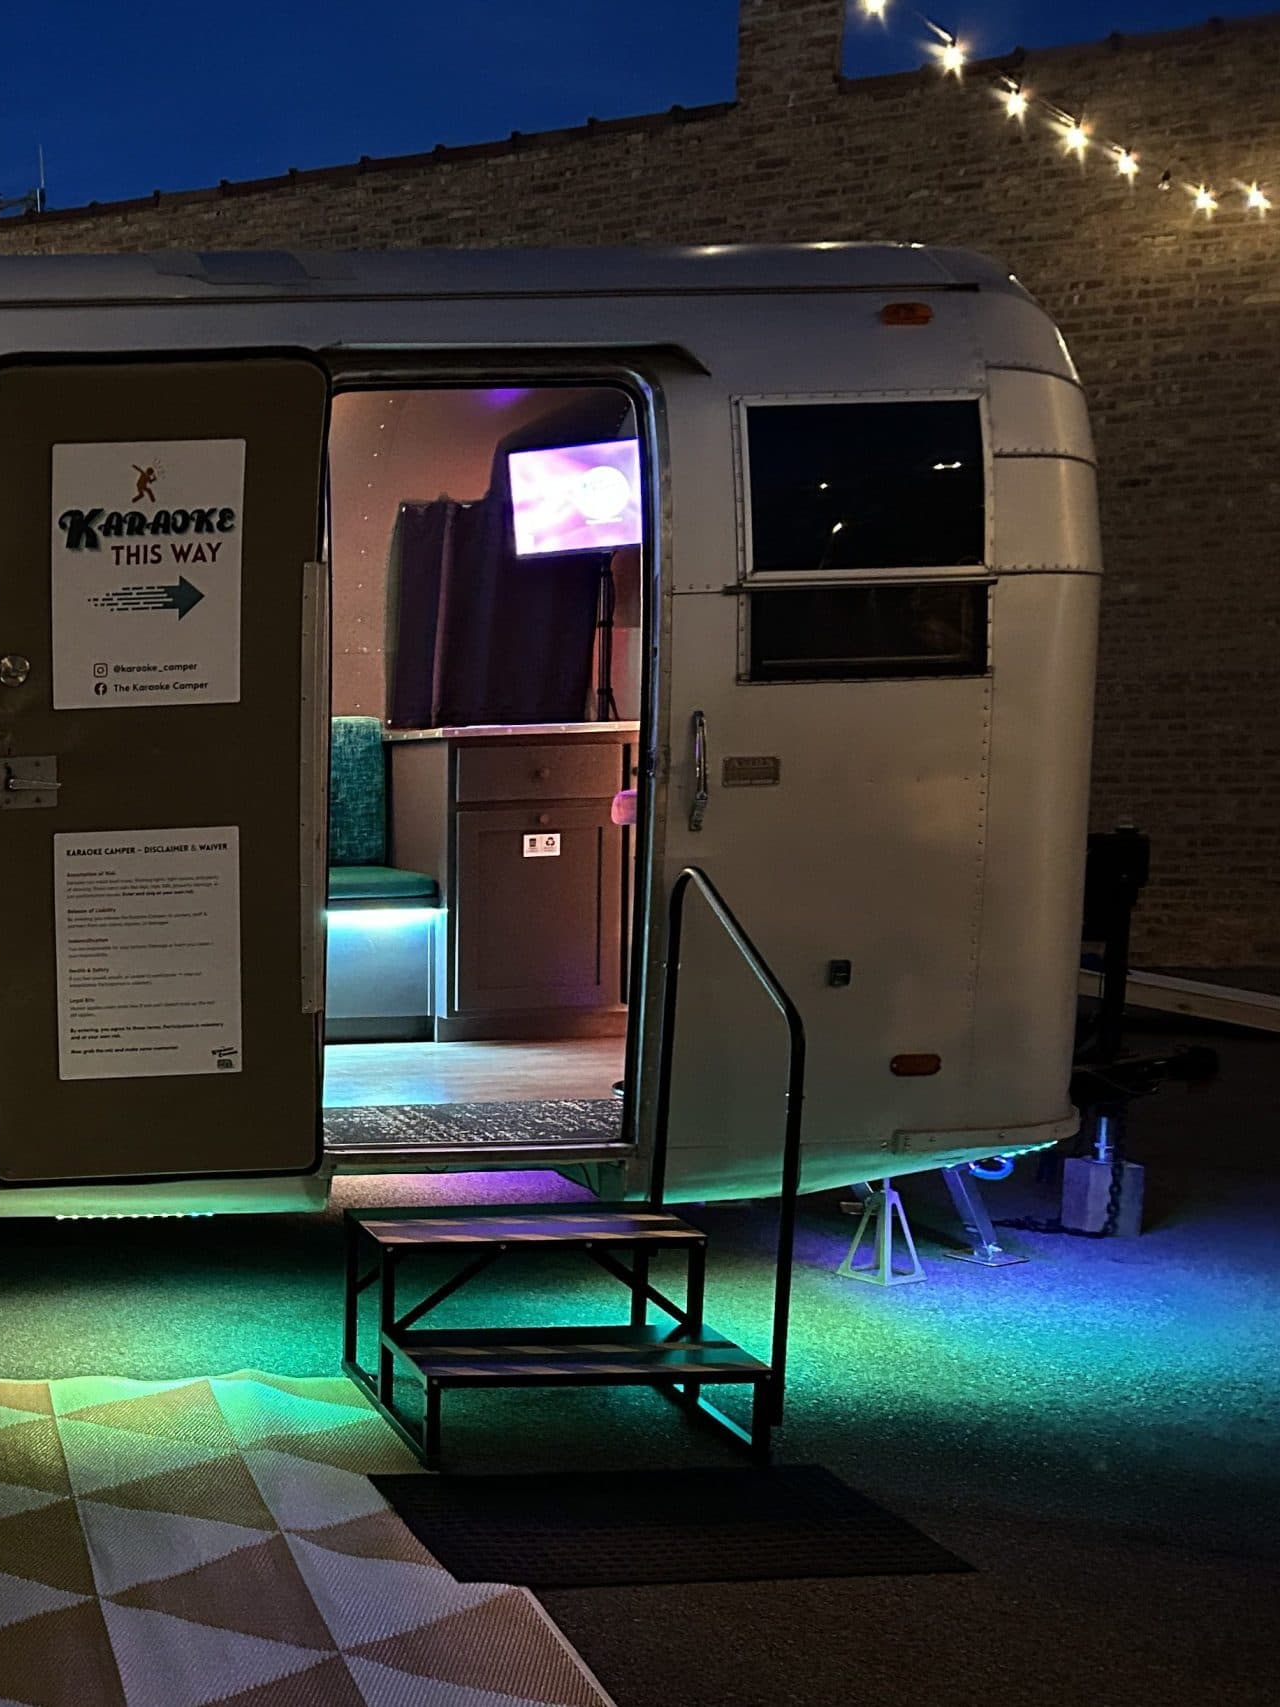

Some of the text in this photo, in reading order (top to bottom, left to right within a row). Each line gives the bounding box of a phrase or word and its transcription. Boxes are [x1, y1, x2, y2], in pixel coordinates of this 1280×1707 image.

[58, 507, 236, 550] KARAOKE
[111, 542, 223, 566] THIS WAY
[113, 662, 198, 674] @karaoke_camper
[113, 681, 209, 693] The Karaoke Camper
[66, 848, 102, 856] KARAOKE
[104, 846, 135, 855] CAMPER
[144, 844, 188, 853] DISCLAIMER
[199, 843, 228, 851] WAIVER
